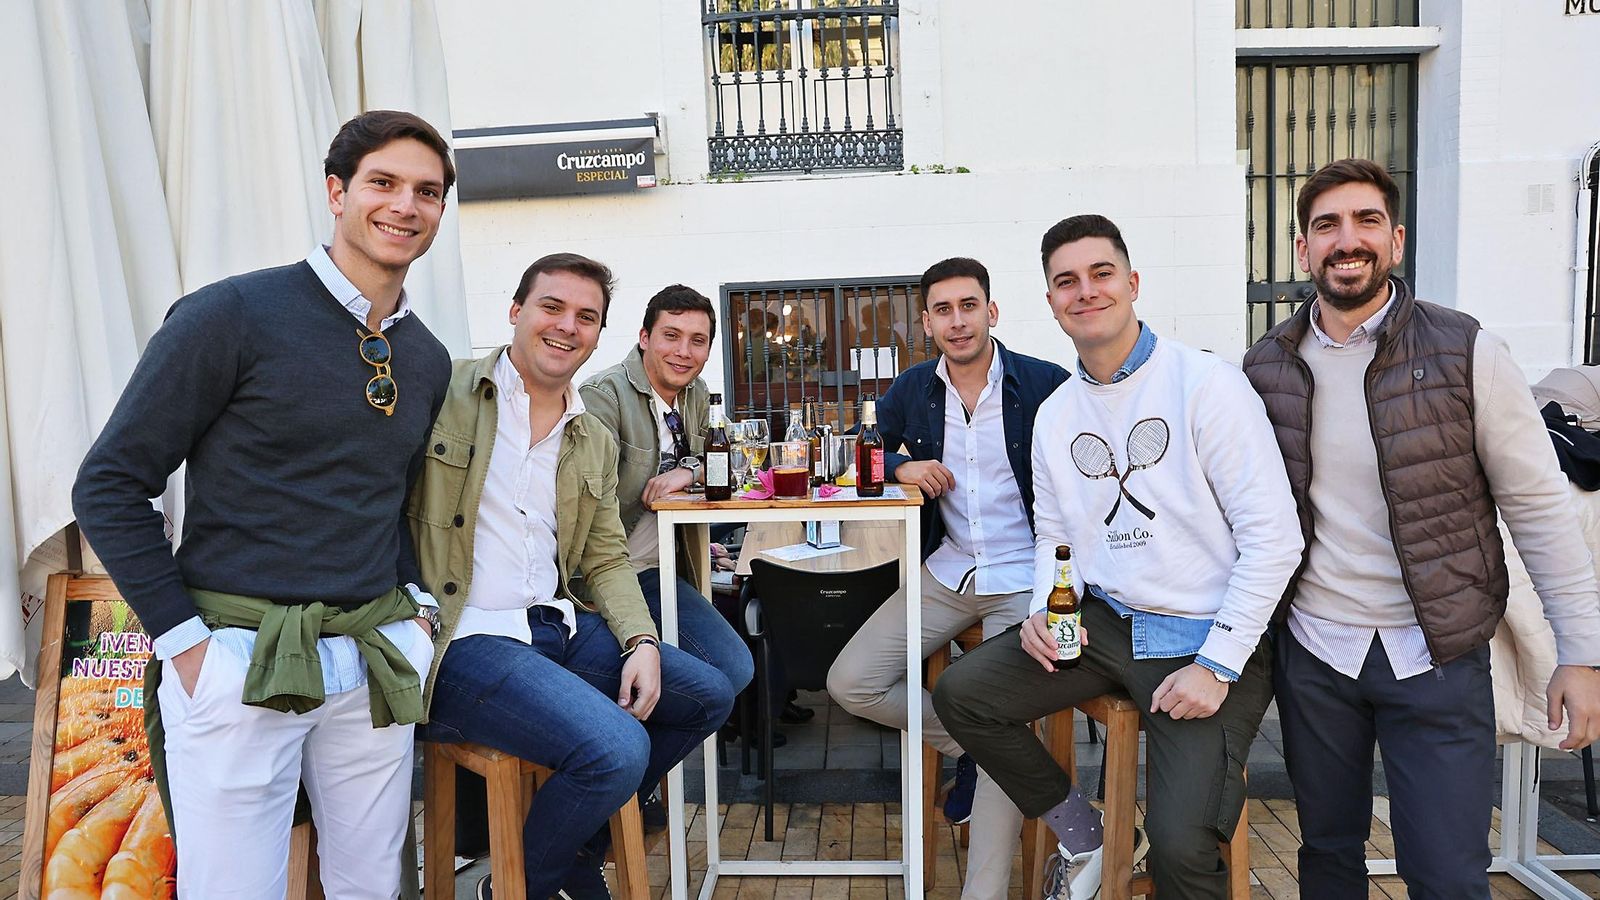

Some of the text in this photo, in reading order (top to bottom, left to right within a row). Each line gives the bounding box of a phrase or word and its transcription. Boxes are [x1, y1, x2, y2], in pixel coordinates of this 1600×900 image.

[557, 151, 645, 170] Cruzcampo
[576, 170, 628, 182] ESPECIAL
[1133, 527, 1153, 540] Co.
[1133, 540, 1147, 548] 2009
[73, 658, 148, 678] NUEST
[116, 687, 144, 708] DE
